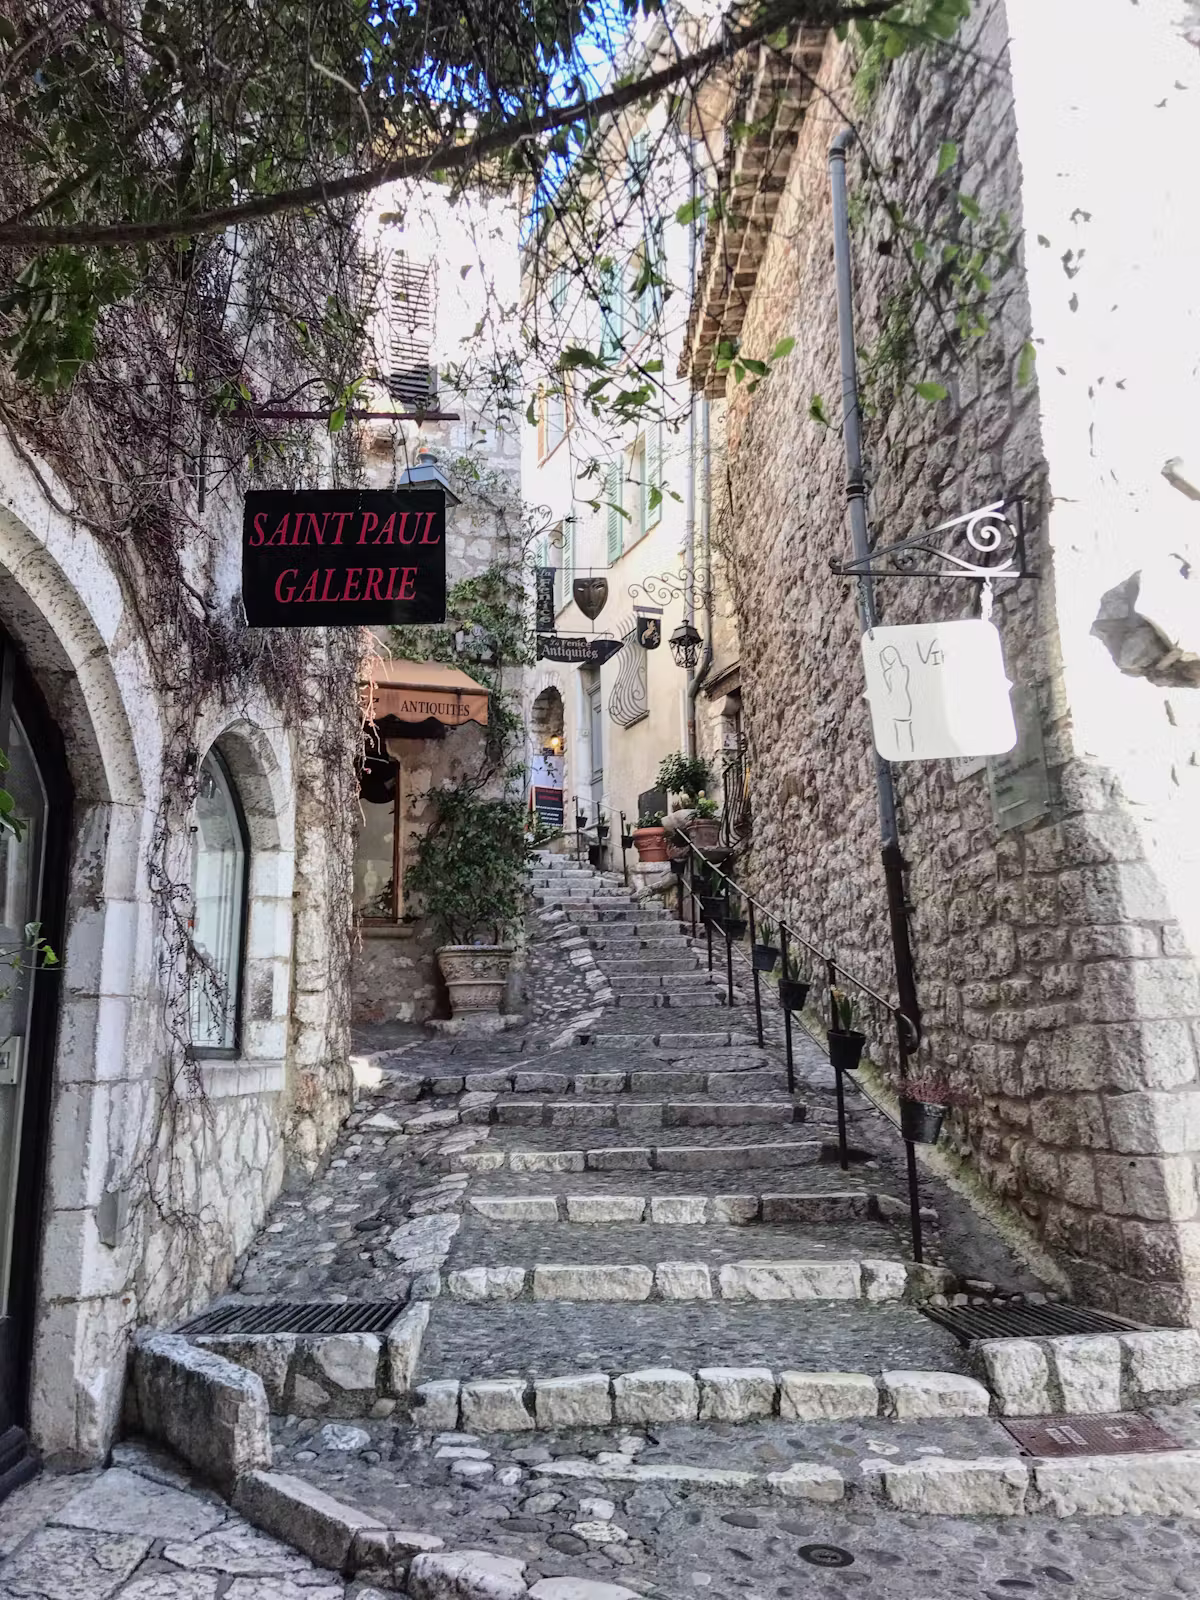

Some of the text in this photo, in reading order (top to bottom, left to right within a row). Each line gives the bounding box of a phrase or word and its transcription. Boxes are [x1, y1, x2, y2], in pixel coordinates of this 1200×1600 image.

[249, 512, 441, 546] SAINT PAUL
[274, 567, 418, 603] GALERIE
[541, 644, 599, 660] Antiquités
[561, 639, 592, 648] Fenice
[400, 700, 470, 717] ANTIQUITES
